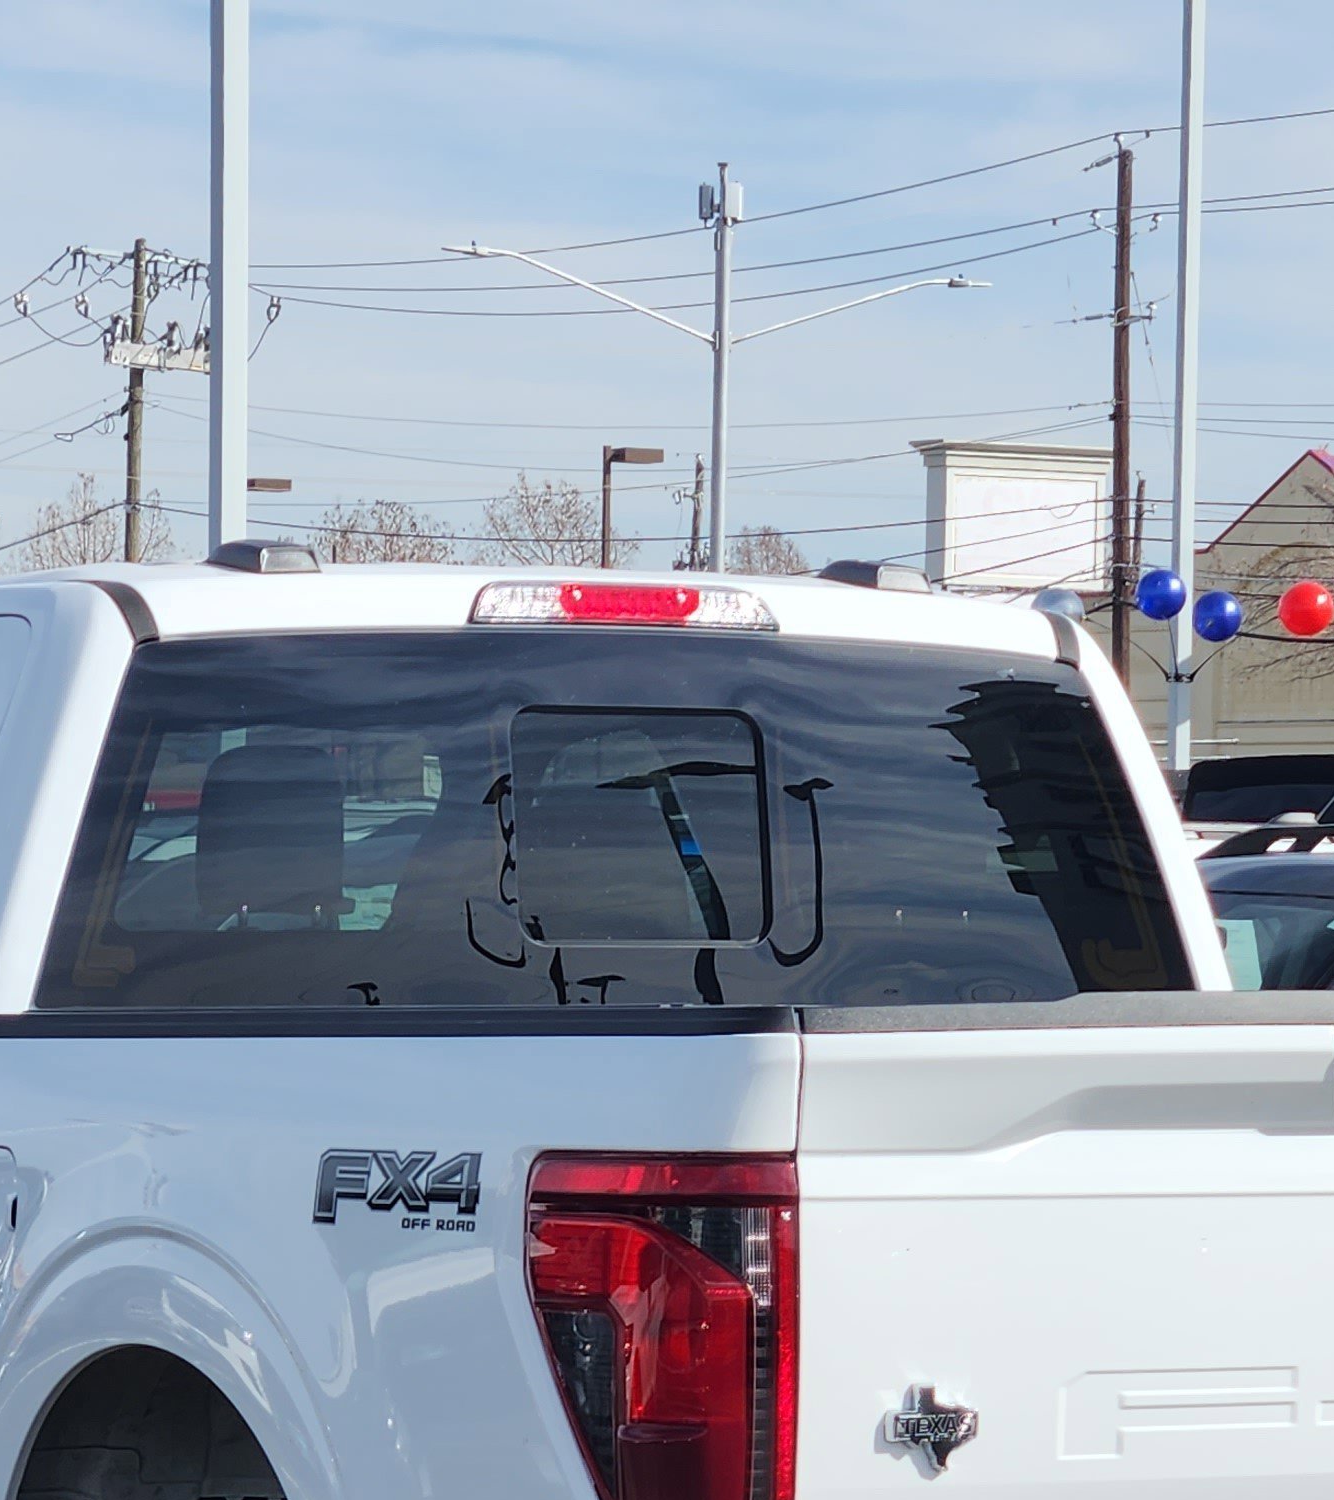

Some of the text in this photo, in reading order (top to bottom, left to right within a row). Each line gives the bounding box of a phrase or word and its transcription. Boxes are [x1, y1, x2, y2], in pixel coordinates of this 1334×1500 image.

[312, 1147, 483, 1224] FX4
[401, 1217, 476, 1232] OFF ROAD
[898, 1411, 974, 1439] TEXAS
